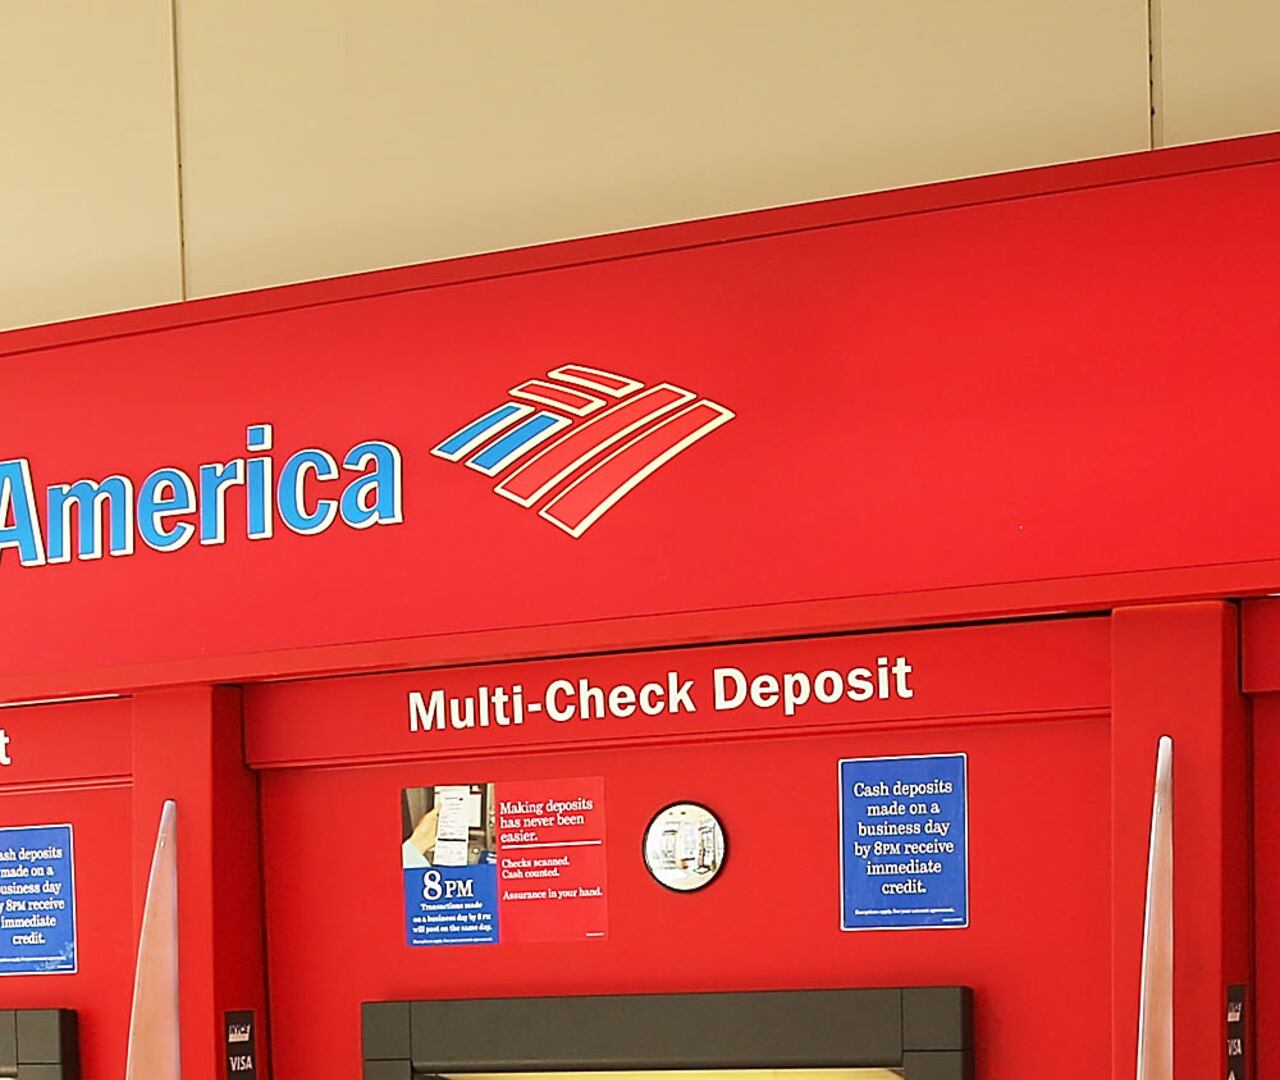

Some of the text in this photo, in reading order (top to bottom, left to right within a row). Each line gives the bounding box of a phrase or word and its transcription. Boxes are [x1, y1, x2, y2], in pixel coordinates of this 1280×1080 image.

[408, 658, 913, 732] Multi-Check Deposit
[854, 779, 952, 797] Cash deposits
[500, 798, 593, 815] Making deposits
[867, 802, 940, 816] made on a
[500, 813, 584, 829] has never been
[858, 820, 950, 836] business day
[501, 831, 538, 843] easier.
[18, 846, 62, 861] deposits
[854, 840, 954, 858] by 8PM receive
[502, 857, 569, 868] Checks scanned.
[867, 859, 942, 875] immediate
[0, 865, 54, 878] made on a
[502, 868, 559, 879] Cash counted.
[42, 880, 61, 895] day
[423, 870, 473, 900] 8 PM
[882, 879, 926, 894] credit.
[503, 887, 602, 900] Assurance in your hand.
[6, 900, 26, 911] 8PM
[28, 898, 64, 910] receive
[1, 915, 56, 928] immediate
[13, 932, 46, 944] credit.
[229, 1056, 252, 1071] VISA
